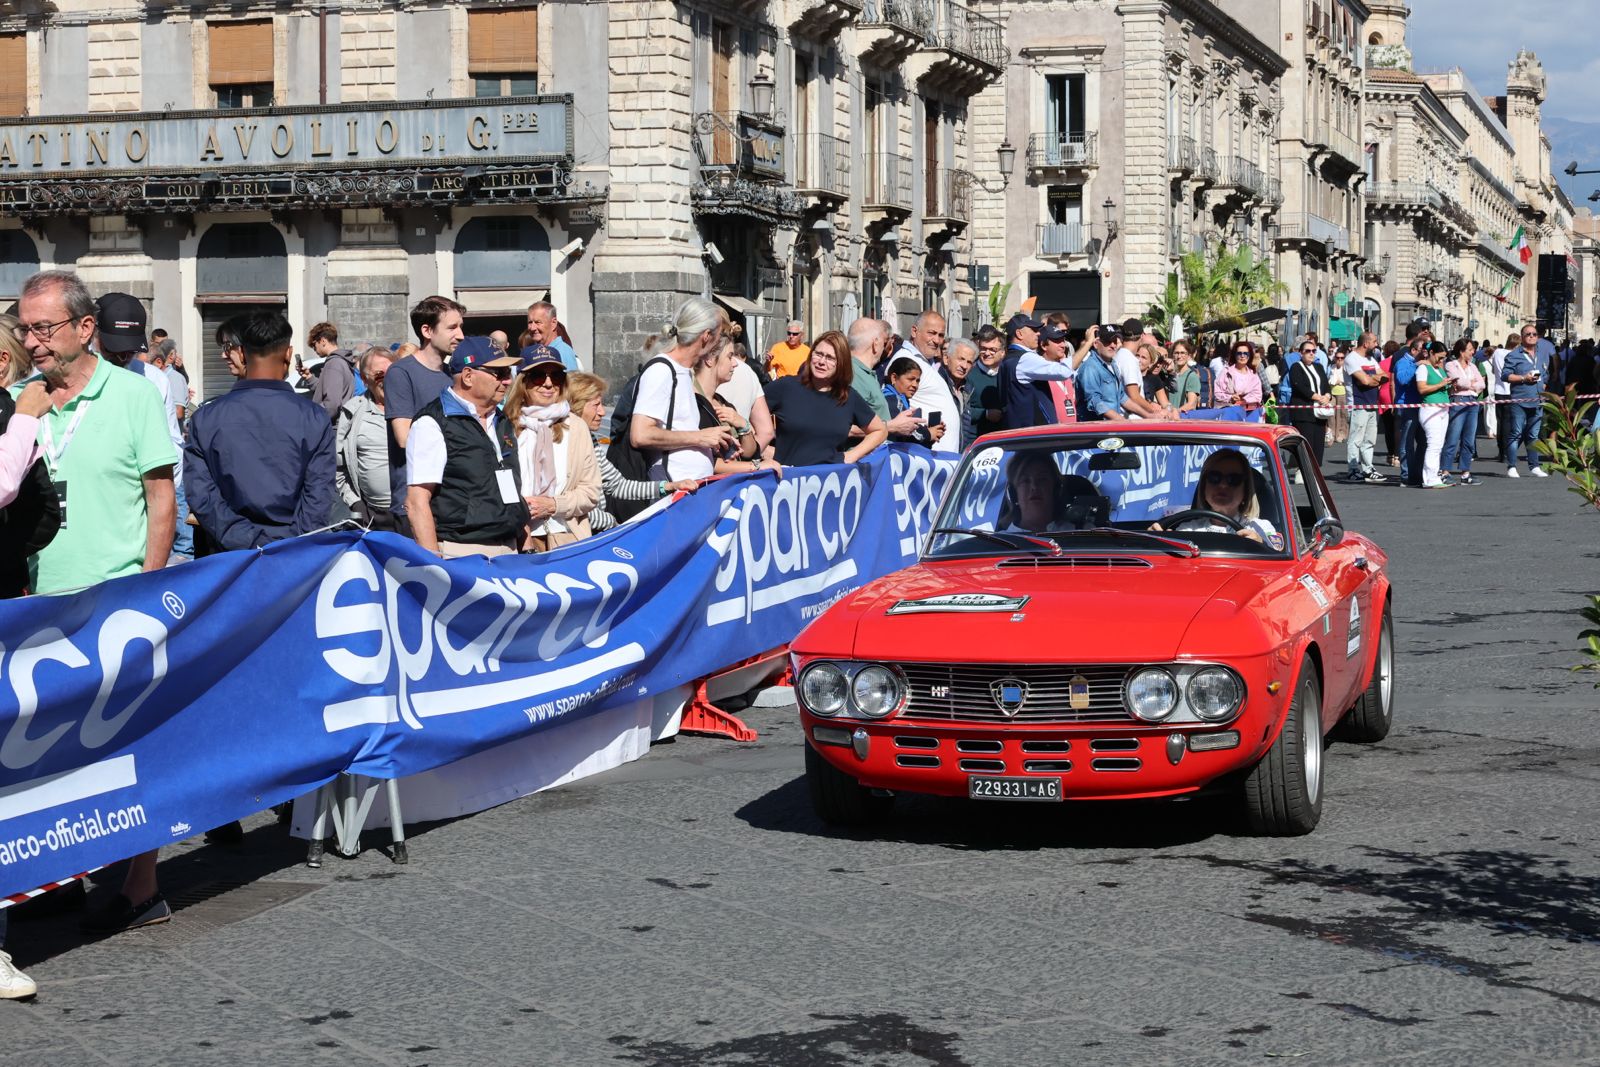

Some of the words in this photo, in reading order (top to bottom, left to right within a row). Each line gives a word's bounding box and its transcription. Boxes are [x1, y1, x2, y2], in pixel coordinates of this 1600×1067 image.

[200, 119, 399, 162] AVOLIO
[166, 182, 271, 197] GIOILLERIA
[432, 172, 539, 190] ARGNTERIA
[975, 457, 998, 468] 168
[707, 467, 863, 624] sparco
[315, 550, 639, 730] sparco
[931, 686, 949, 697] HF
[974, 780, 1028, 797] 229331
[1038, 782, 1057, 797] AG
